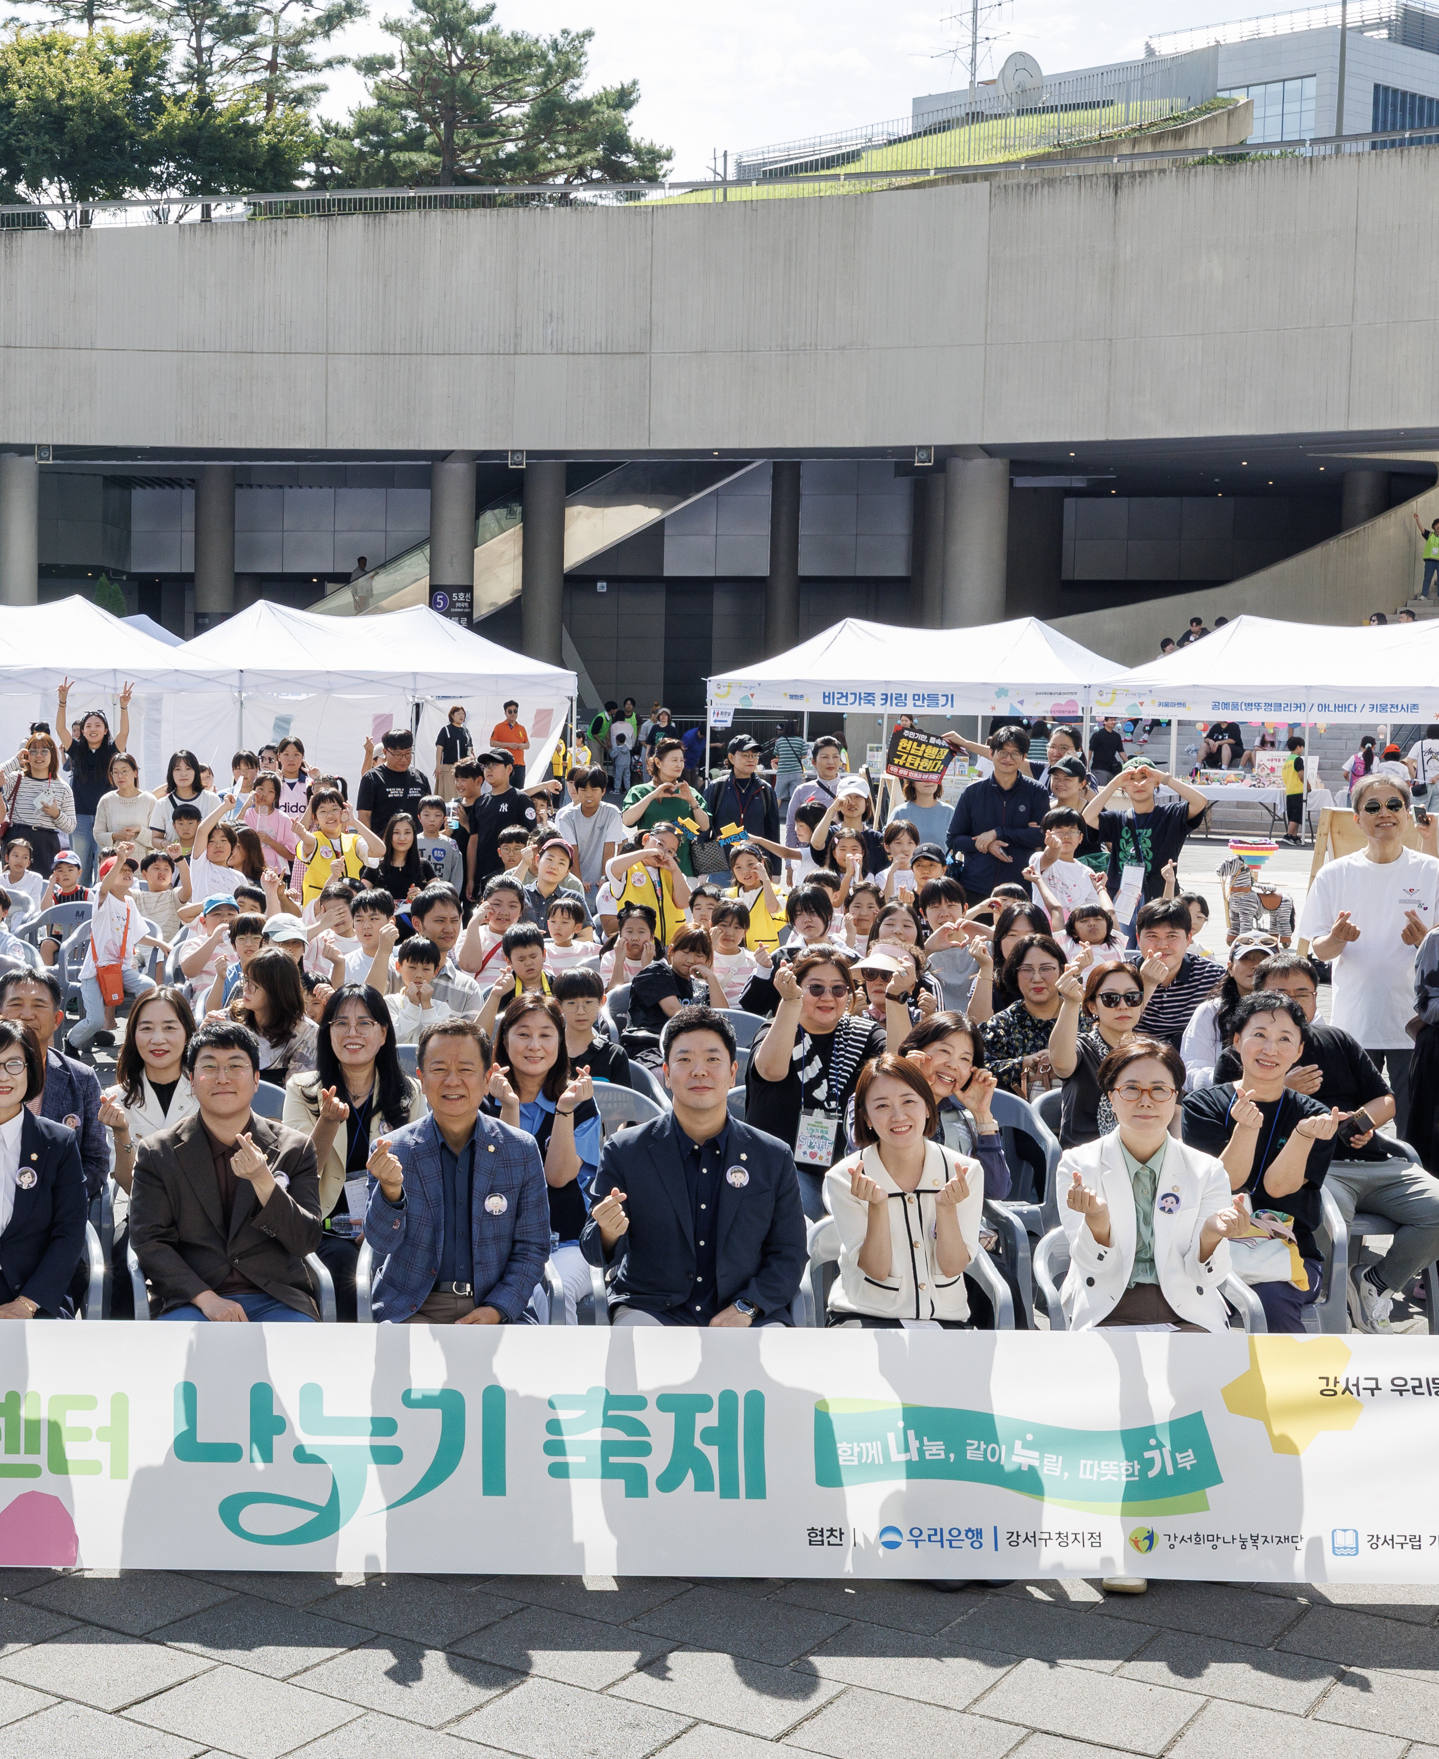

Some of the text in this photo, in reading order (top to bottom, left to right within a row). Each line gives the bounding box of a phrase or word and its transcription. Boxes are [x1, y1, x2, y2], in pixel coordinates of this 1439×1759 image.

[436, 595, 444, 608] 5
[452, 592, 471, 602] 5호선
[822, 691, 954, 709] 비건가죽 키링 만들기
[1157, 701, 1187, 709] 키움마켓6
[1211, 701, 1306, 713] 공예품(병뚜껑클리커)
[1317, 703, 1358, 713] 아나바다
[1368, 704, 1420, 714] 키움전시존
[897, 738, 950, 760] 헌납행정
[893, 751, 944, 773] 규탄한다!
[279, 802, 307, 813] dida
[798, 1135, 833, 1150] STAFF
[1318, 1376, 1382, 1398] 강서구
[173, 1380, 507, 1547] 나누기
[542, 1385, 767, 1500] 축제
[837, 1427, 1197, 1482] 함께 나눔, 같이 누림, 따뜻한 기부
[807, 1526, 845, 1547] 협찬
[906, 1525, 1102, 1550] 우리은행 강서구청지점
[1163, 1531, 1304, 1551] 강서희망나눔복지재단
[1366, 1533, 1422, 1551] 강서구립
